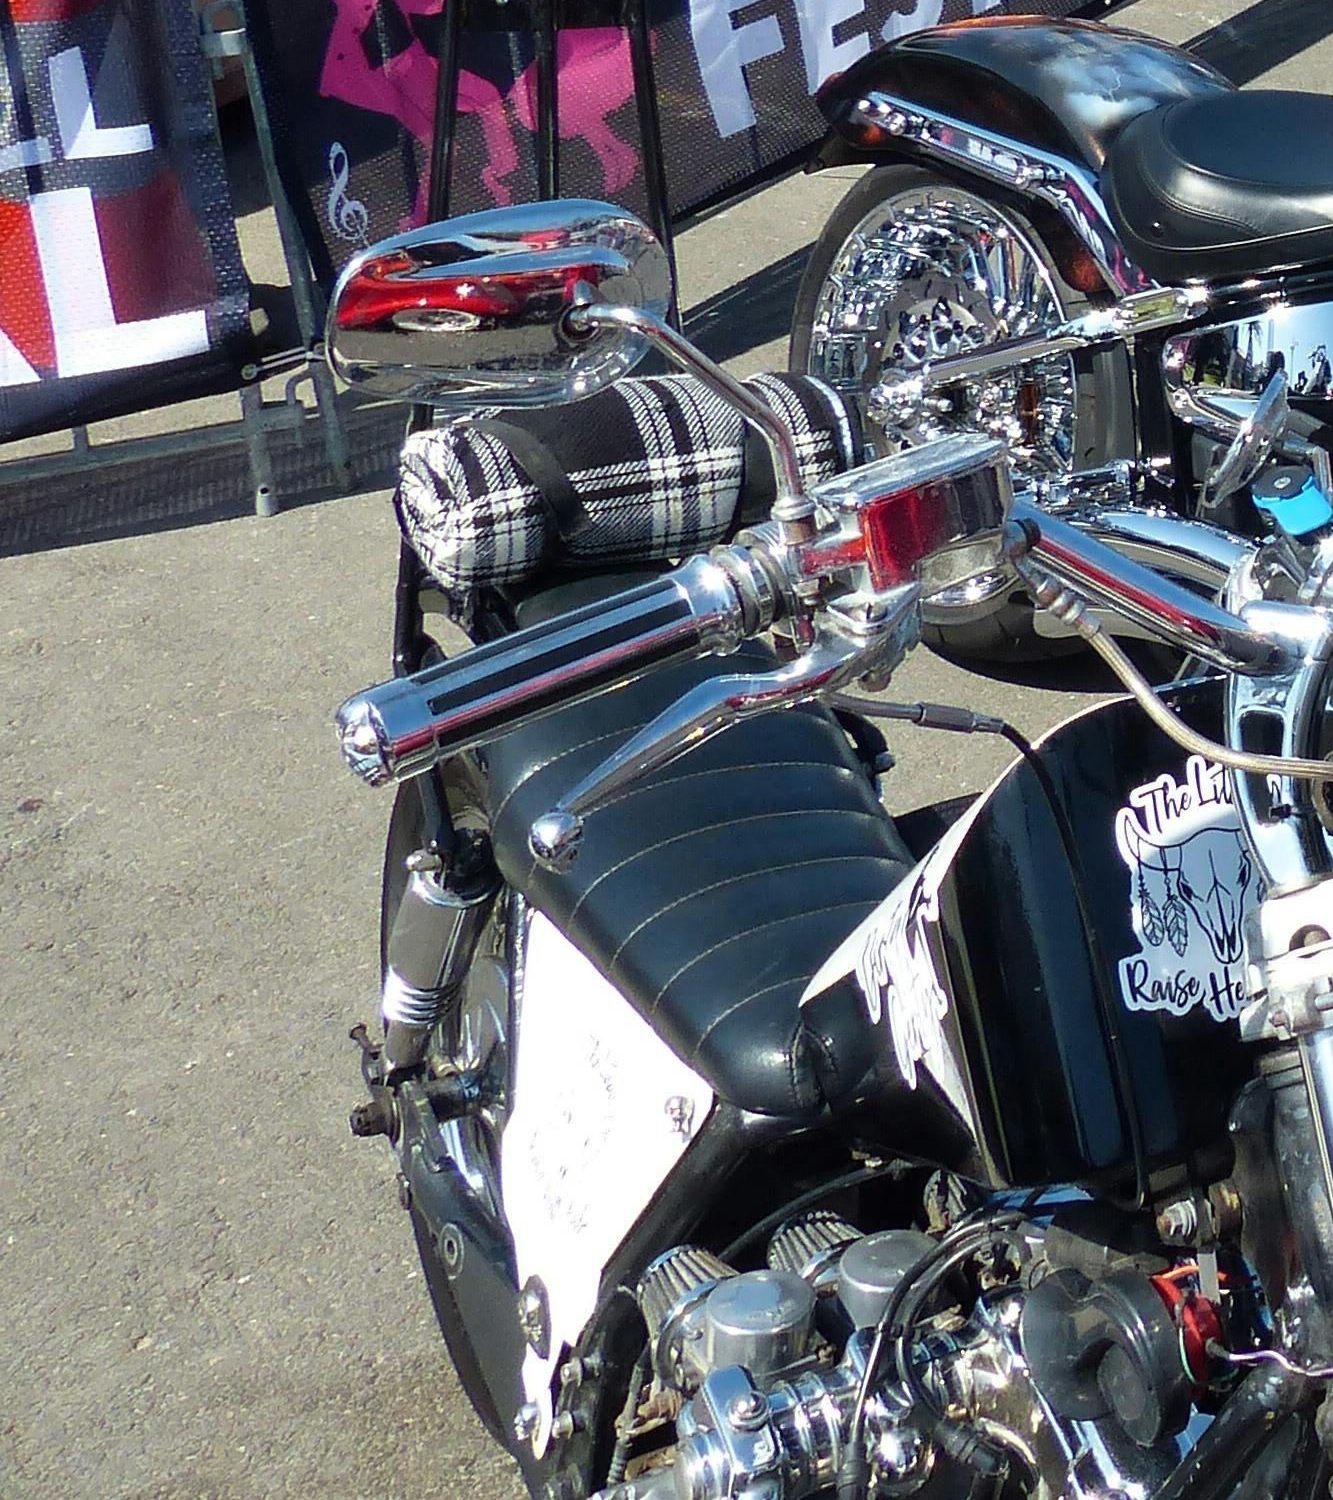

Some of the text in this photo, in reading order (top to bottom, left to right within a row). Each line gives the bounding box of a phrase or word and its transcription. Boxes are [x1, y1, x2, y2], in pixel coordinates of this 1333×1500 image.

[1138, 781, 1192, 834] The
[1126, 959, 1245, 1015] Raise He
